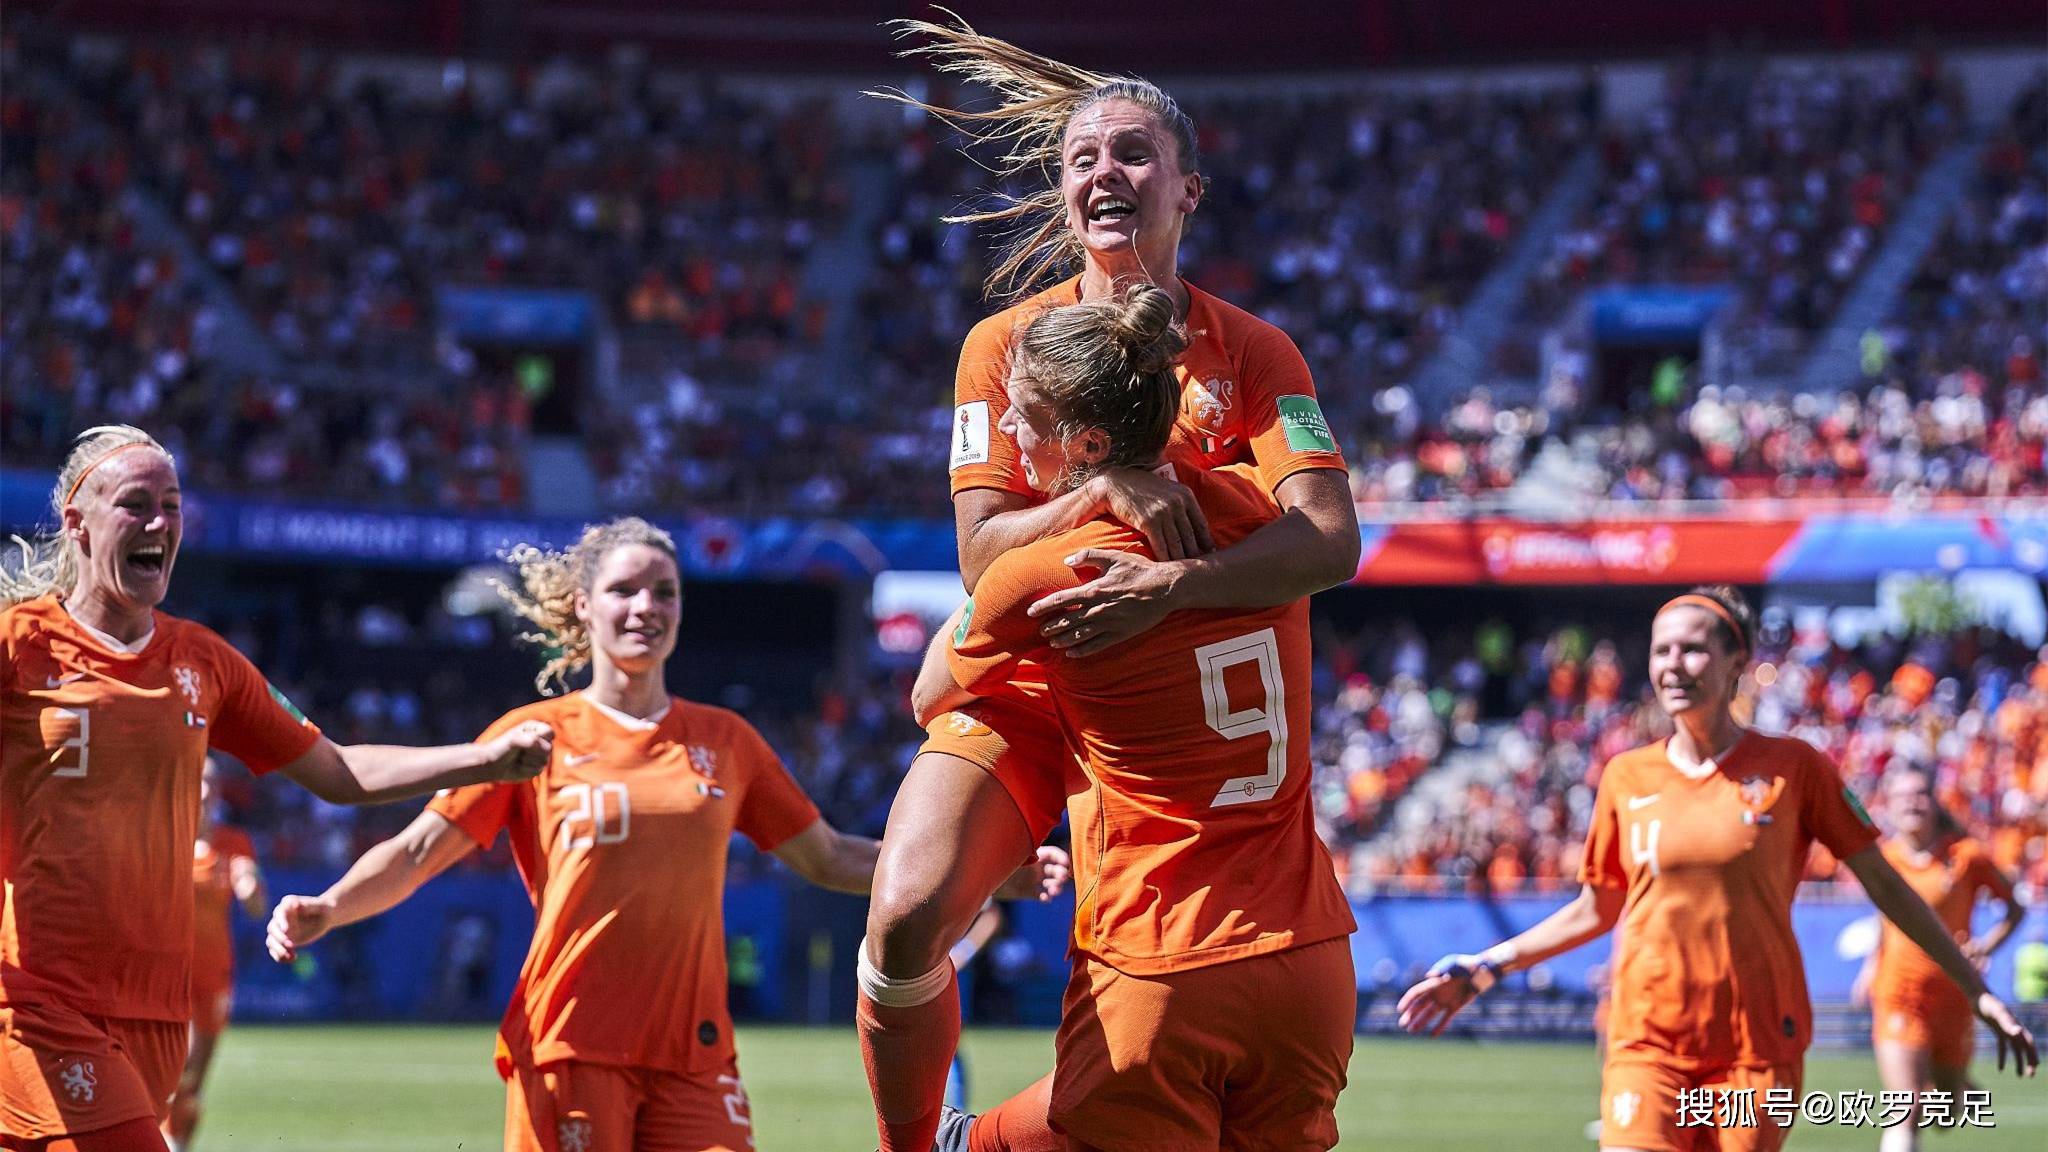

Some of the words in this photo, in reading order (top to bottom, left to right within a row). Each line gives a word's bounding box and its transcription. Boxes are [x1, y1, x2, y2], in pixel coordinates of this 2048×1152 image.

[1285, 411, 1325, 421] LIVING
[1287, 417, 1326, 428] FOOTBALL
[1314, 429, 1330, 439] FIFA
[52, 708, 90, 777] 3
[1195, 627, 1288, 807] 9
[557, 782, 631, 851] 20
[1630, 819, 1661, 877] 4
